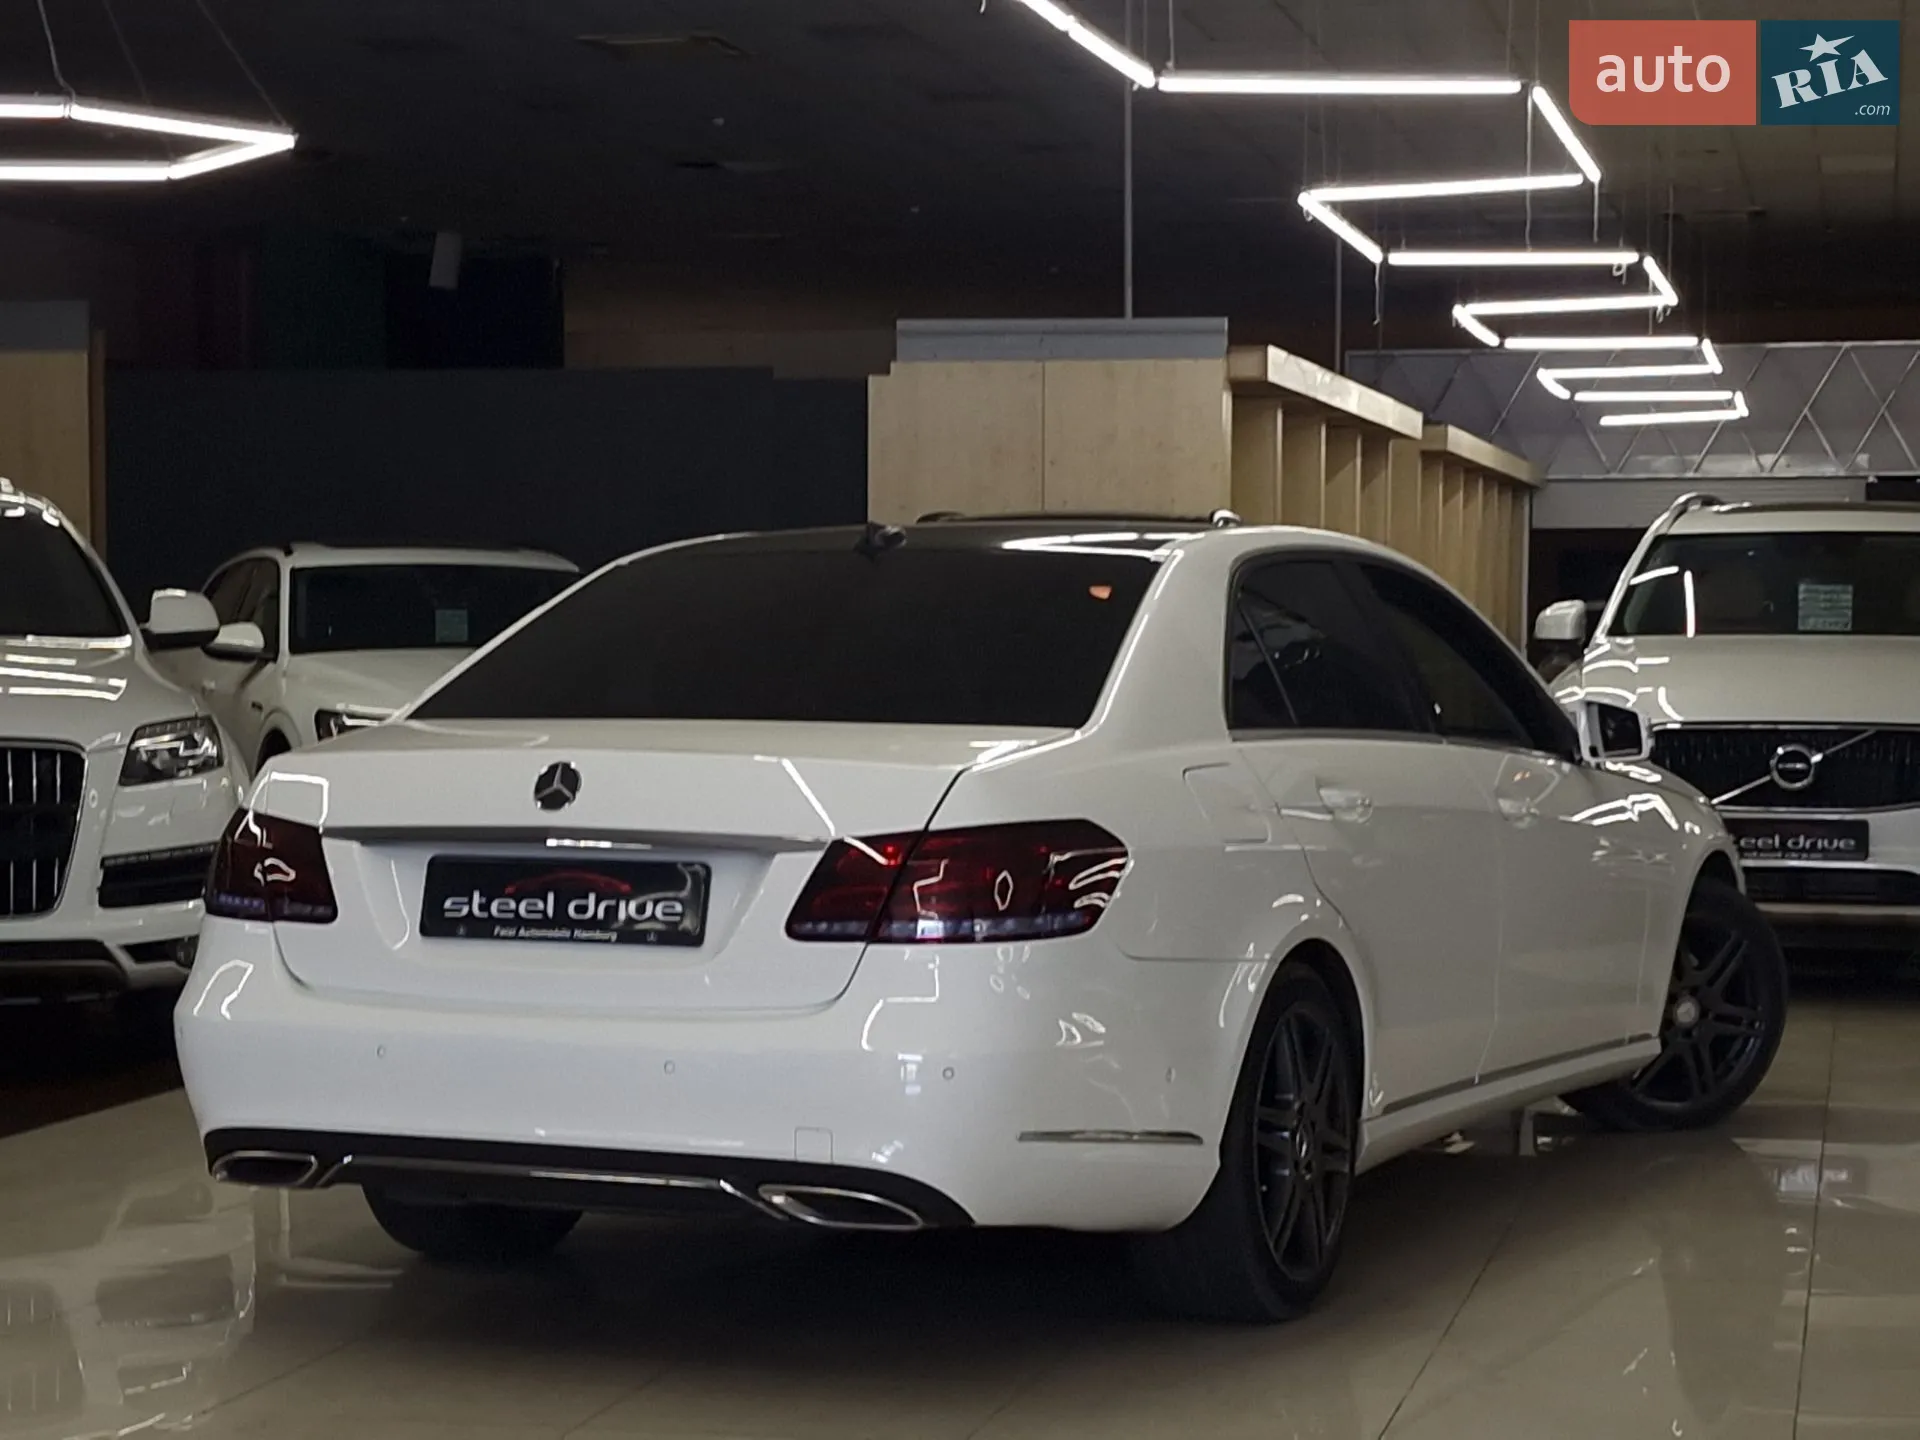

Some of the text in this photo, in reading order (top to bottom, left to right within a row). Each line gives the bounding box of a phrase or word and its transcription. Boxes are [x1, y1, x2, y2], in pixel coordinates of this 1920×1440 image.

[1786, 834, 1857, 851] drive
[443, 889, 684, 923] steel drive
